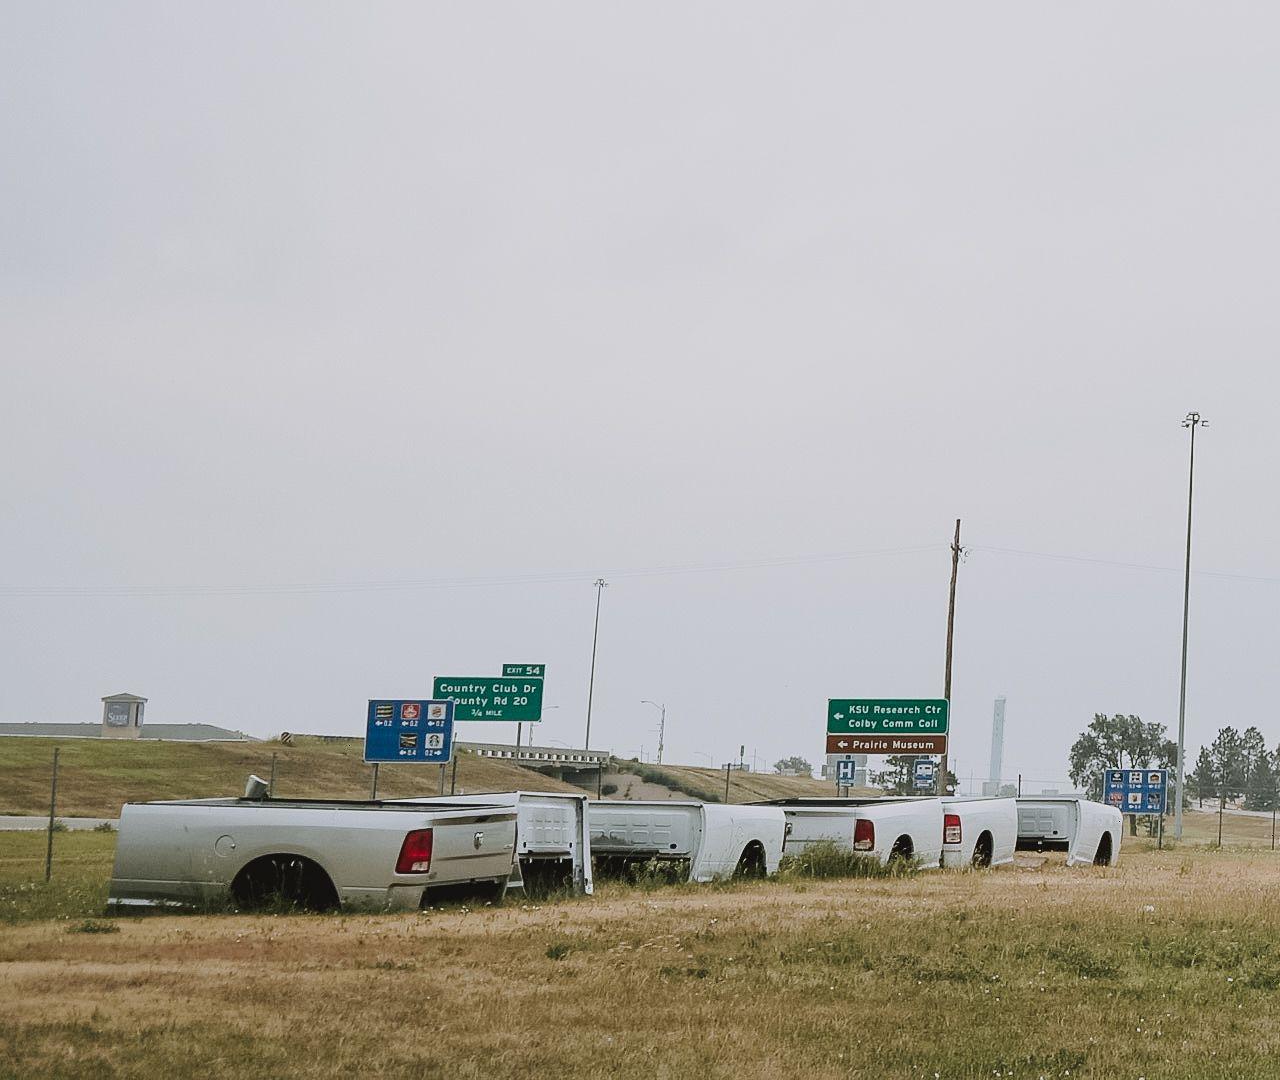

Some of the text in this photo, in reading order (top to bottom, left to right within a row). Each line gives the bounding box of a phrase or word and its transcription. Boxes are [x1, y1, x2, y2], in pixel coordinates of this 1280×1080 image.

[526, 666, 540, 675] 54
[440, 684, 537, 693] Country Club Dr
[494, 697, 507, 705] Rd
[513, 697, 528, 705] 20
[849, 705, 941, 714] KSU Research Ctr
[848, 719, 938, 729] Colby Comm Coll
[853, 741, 934, 749] Prairie Museum
[840, 762, 852, 778] H
